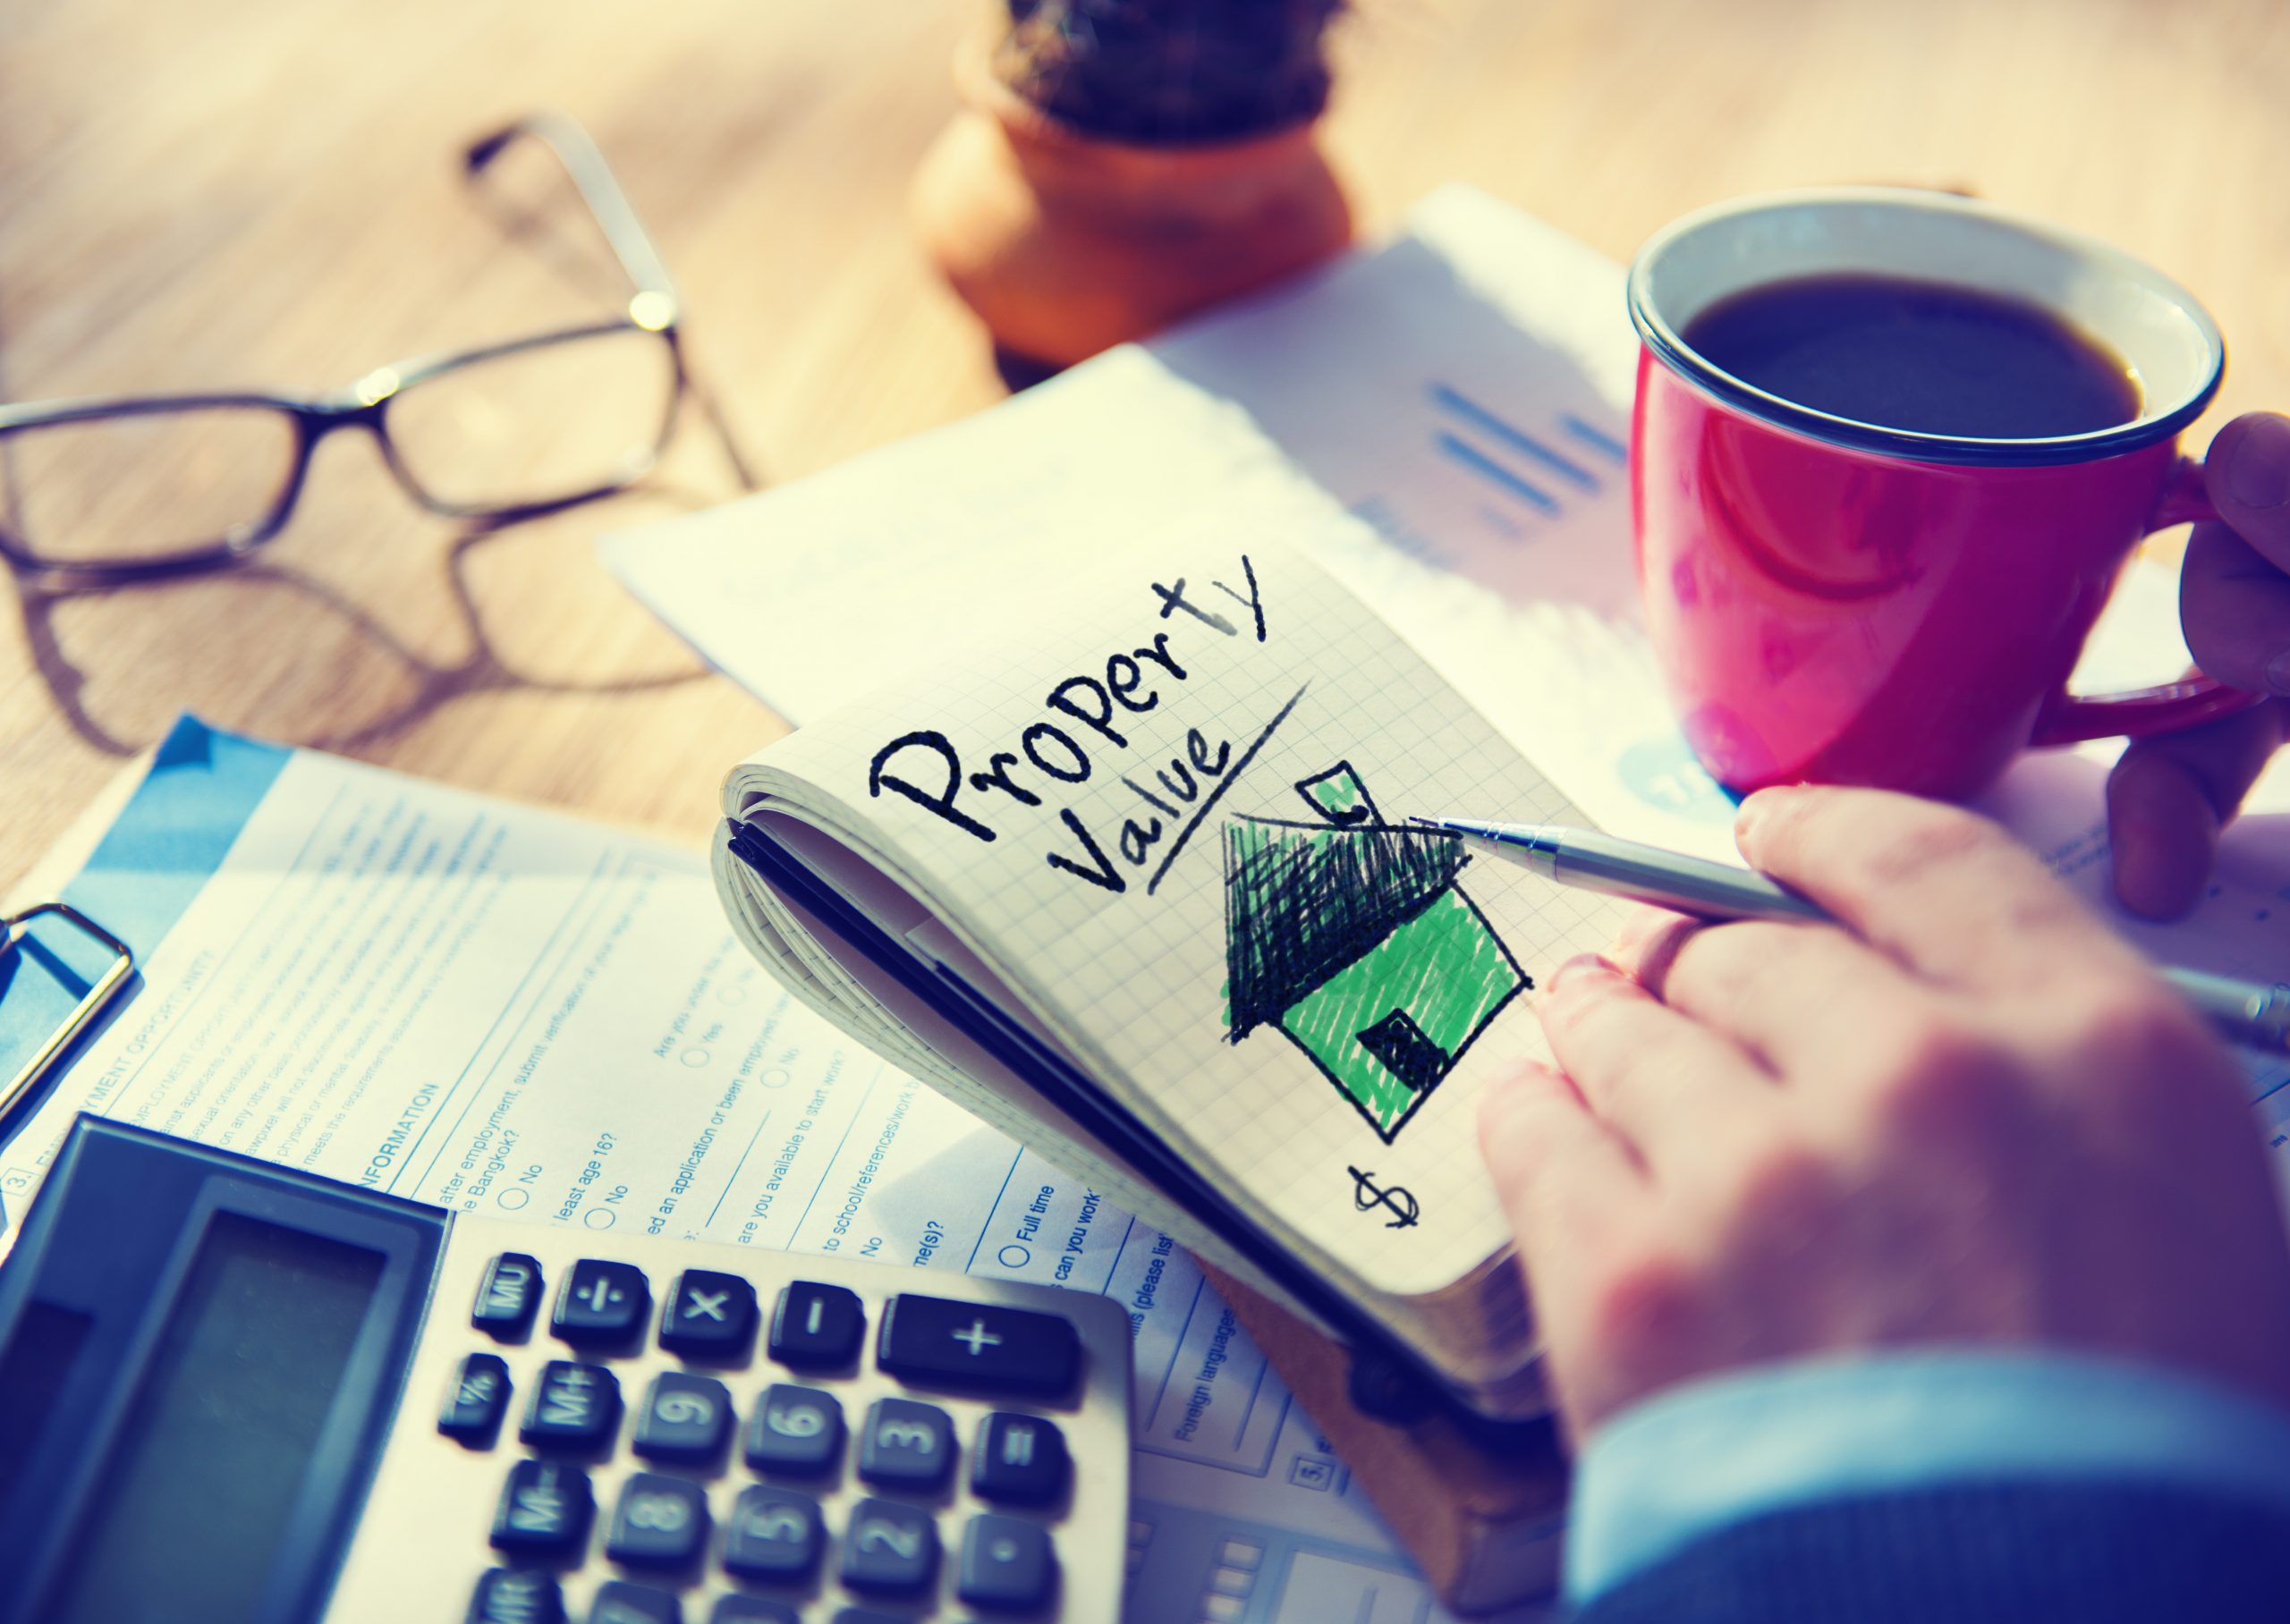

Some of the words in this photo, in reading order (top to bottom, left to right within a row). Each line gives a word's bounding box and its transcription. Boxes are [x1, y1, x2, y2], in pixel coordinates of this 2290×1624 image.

[869, 554, 1267, 841] Property
[1047, 728, 1231, 892] Value
[710, 1111, 725, 1125] or
[717, 1079, 744, 1109] been
[276, 1112, 315, 1158] physical
[302, 1131, 334, 1166] meets
[326, 1112, 347, 1130] the
[438, 1171, 466, 1205] after
[460, 1089, 522, 1171] employment,
[466, 1129, 521, 1197] Bangkok?
[518, 1165, 543, 1184] No
[553, 1188, 586, 1221] least
[579, 1161, 601, 1185] age
[593, 1133, 617, 1155] 16?
[670, 1129, 717, 1195] application
[738, 1222, 758, 1244] are
[751, 1195, 773, 1219] you
[766, 1135, 804, 1191] available
[795, 1120, 812, 1131] to
[806, 1089, 828, 1116] start
[822, 1239, 840, 1251] to
[833, 1094, 911, 1235] school/references/work
[604, 1185, 628, 1205] No
[659, 1197, 677, 1214] an
[1016, 1215, 1041, 1242] Full
[1030, 1186, 1055, 1214] time
[1347, 1164, 1421, 1228] $
[860, 1237, 883, 1257] No
[1055, 1256, 1075, 1281] can
[1065, 1227, 1087, 1255] you
[488, 1264, 530, 1309] MU
[1132, 1258, 1166, 1309] (please
[541, 1366, 596, 1426] M+
[655, 1391, 714, 1426] 9
[767, 1404, 826, 1438] 6
[1174, 1383, 1212, 1442] Foreign
[878, 1418, 936, 1455] 3
[626, 1493, 691, 1533] 8
[860, 1519, 921, 1561] 2
